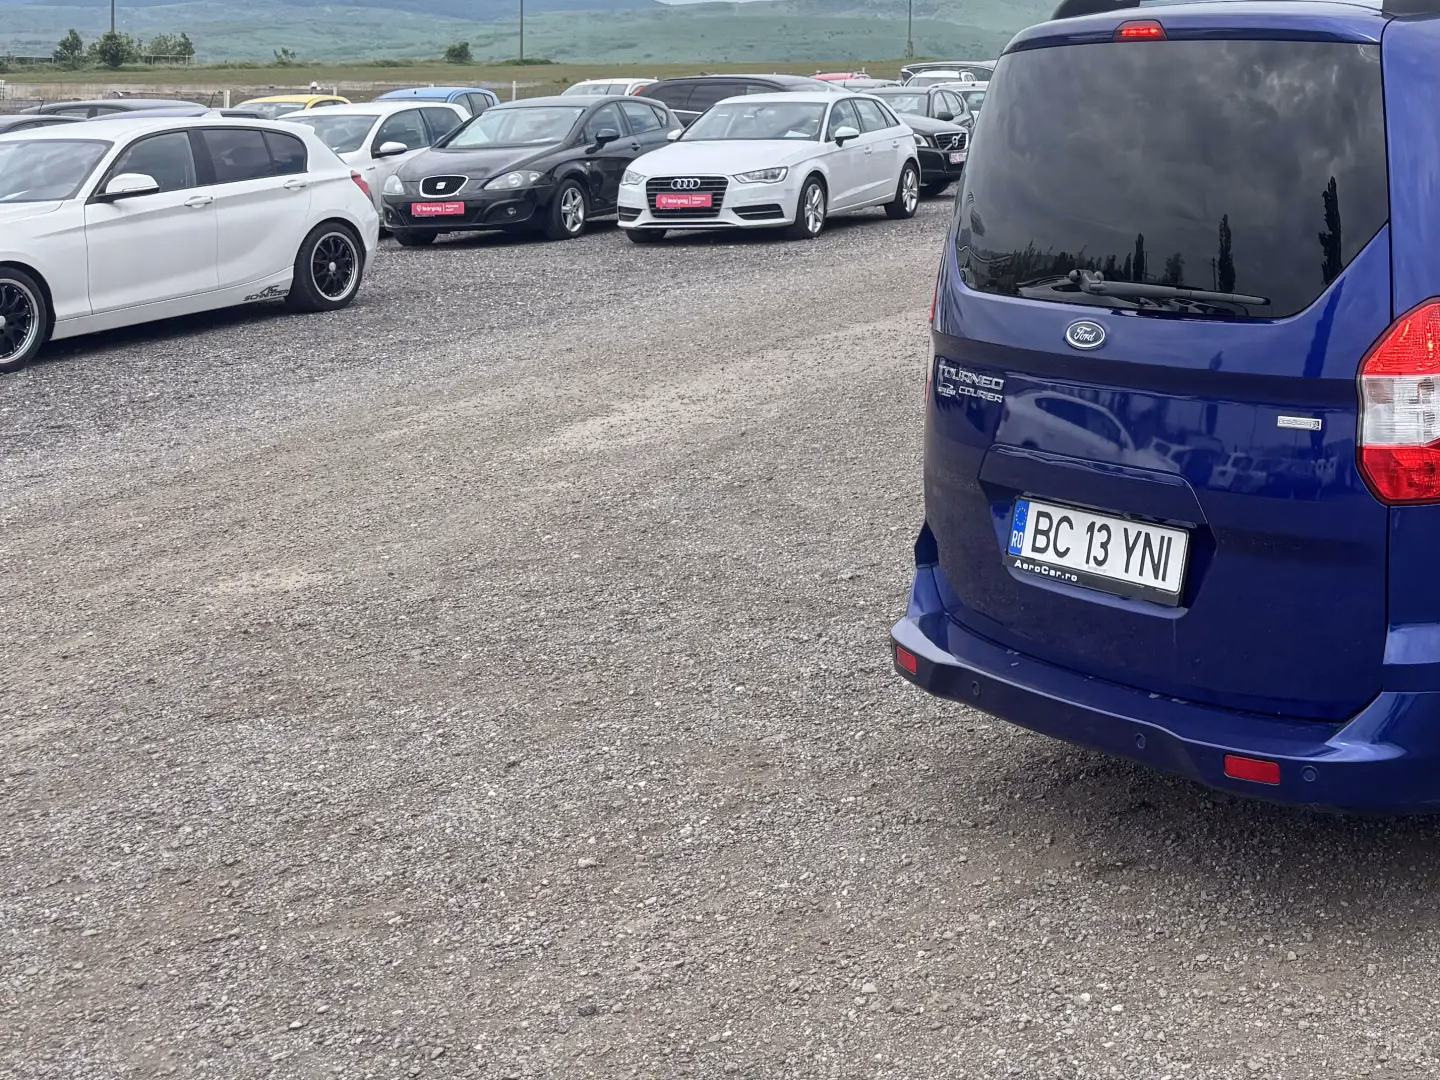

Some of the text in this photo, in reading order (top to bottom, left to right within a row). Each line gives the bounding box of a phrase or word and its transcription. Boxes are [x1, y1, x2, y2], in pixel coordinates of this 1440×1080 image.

[1074, 326, 1097, 342] Ford
[937, 364, 1004, 390] TOURNEO
[958, 385, 1004, 403] COURIER
[1011, 530, 1024, 549] RO
[1031, 510, 1173, 582] BC 13 YNI
[1013, 559, 1078, 582] AeroCar.ro
